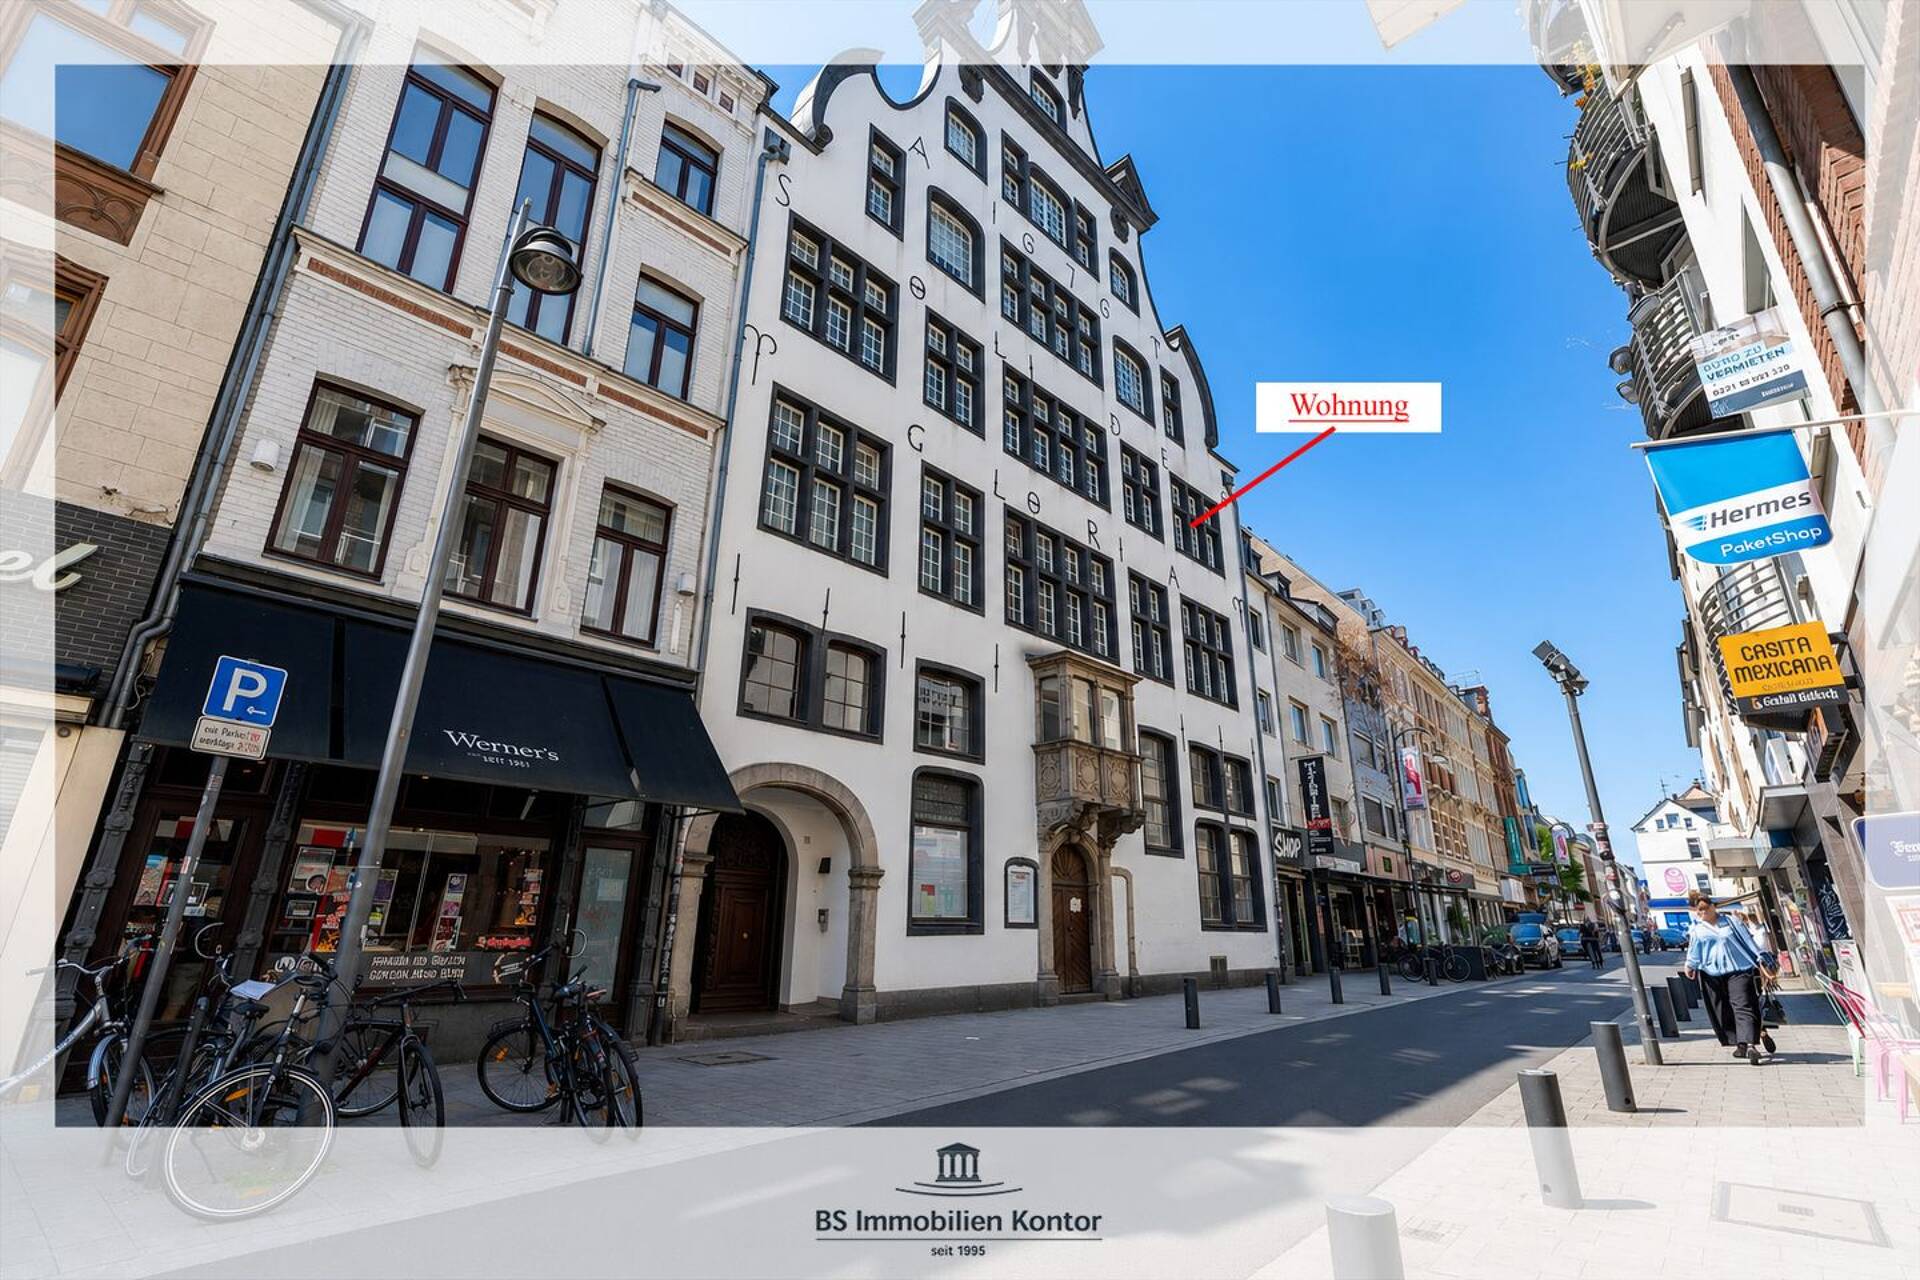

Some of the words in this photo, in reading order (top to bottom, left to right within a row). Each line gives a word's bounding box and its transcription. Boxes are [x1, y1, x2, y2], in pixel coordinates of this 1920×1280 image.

[1707, 346, 1786, 381] VERMIETEN
[1711, 491, 1812, 528] Hermes
[1720, 527, 1823, 557] PaketShop
[1741, 636, 1813, 662] CASITA
[222, 667, 268, 712] P
[442, 728, 560, 761] Werner's
[1274, 831, 1302, 859] SHOP
